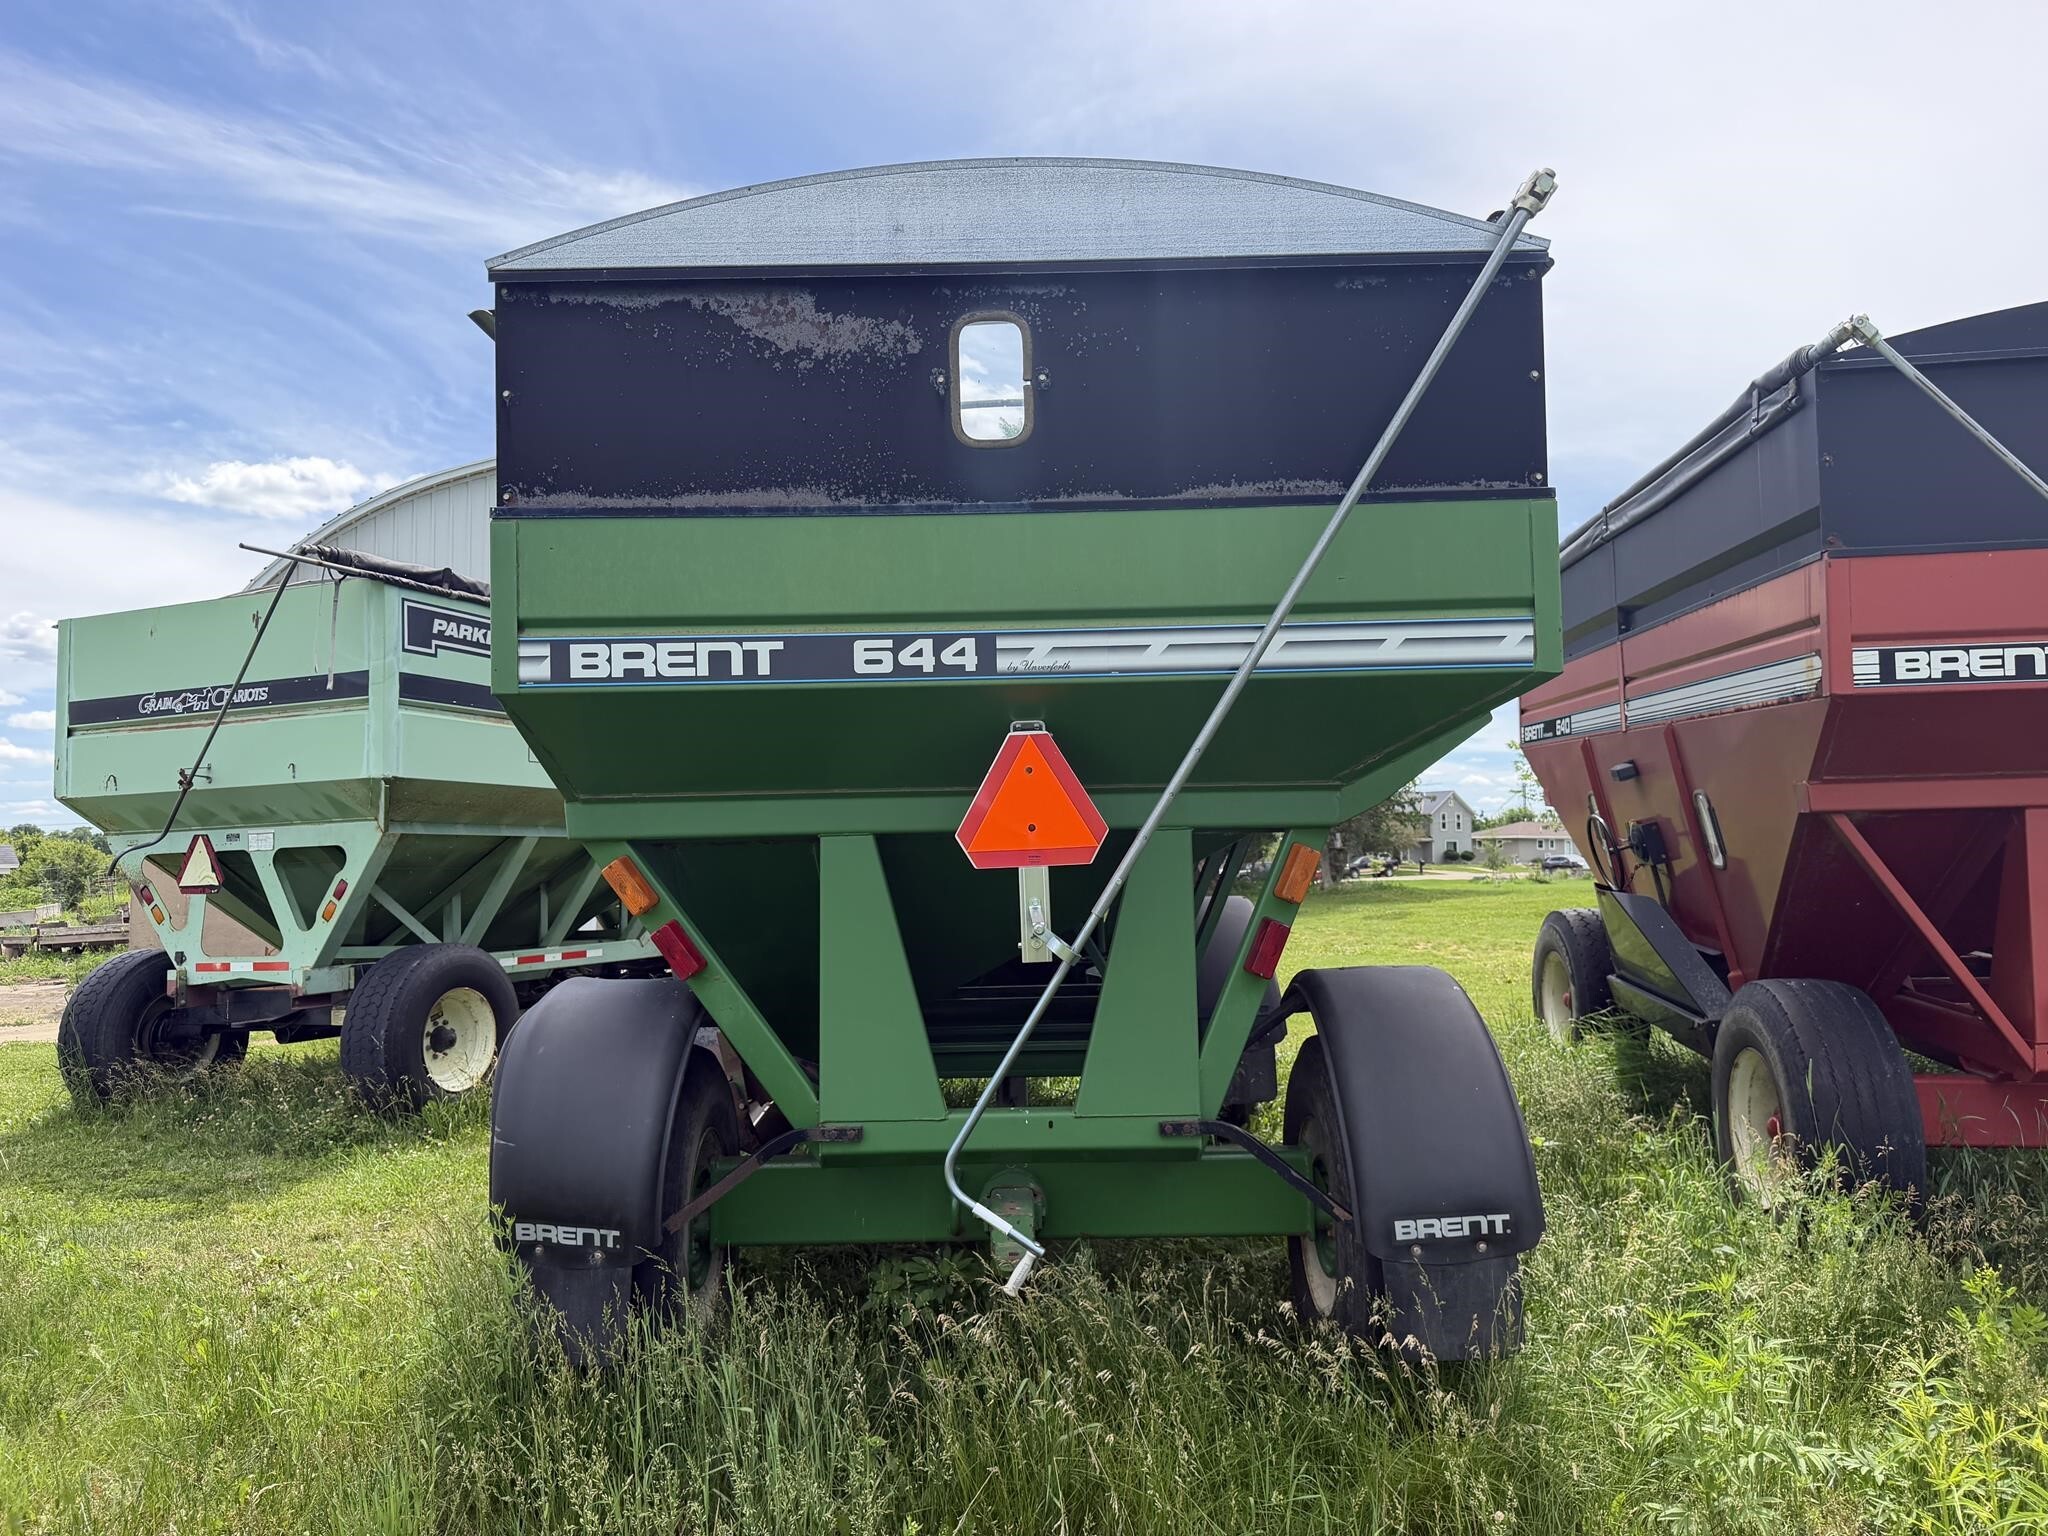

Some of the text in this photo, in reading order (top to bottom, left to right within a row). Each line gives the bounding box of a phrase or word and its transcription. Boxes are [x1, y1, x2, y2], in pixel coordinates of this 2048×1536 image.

[570, 637, 978, 678] BRENT 644
[1007, 662, 1018, 672] by
[1895, 647, 2048, 680] BREN
[1556, 717, 1570, 736] 640
